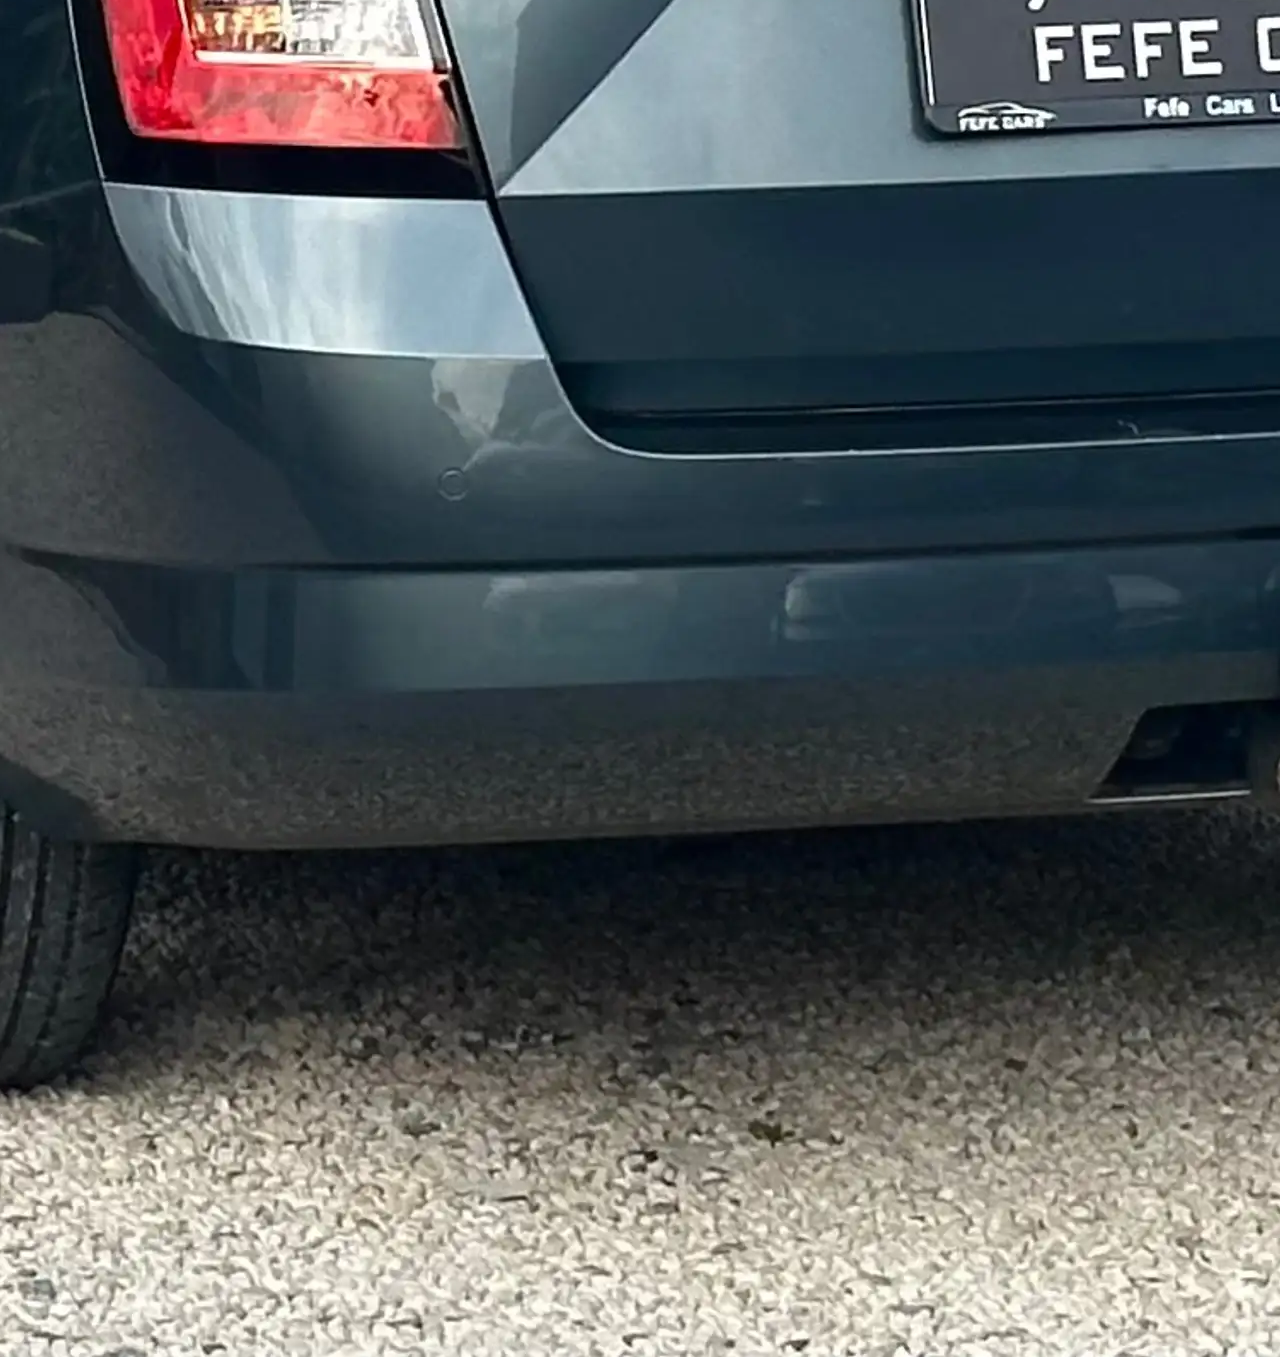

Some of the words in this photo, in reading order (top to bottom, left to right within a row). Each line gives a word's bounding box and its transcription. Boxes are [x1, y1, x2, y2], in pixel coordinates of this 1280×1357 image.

[1033, 17, 1224, 83] FEFE
[1142, 96, 1191, 119] Fefe
[1204, 94, 1257, 117] Cars
